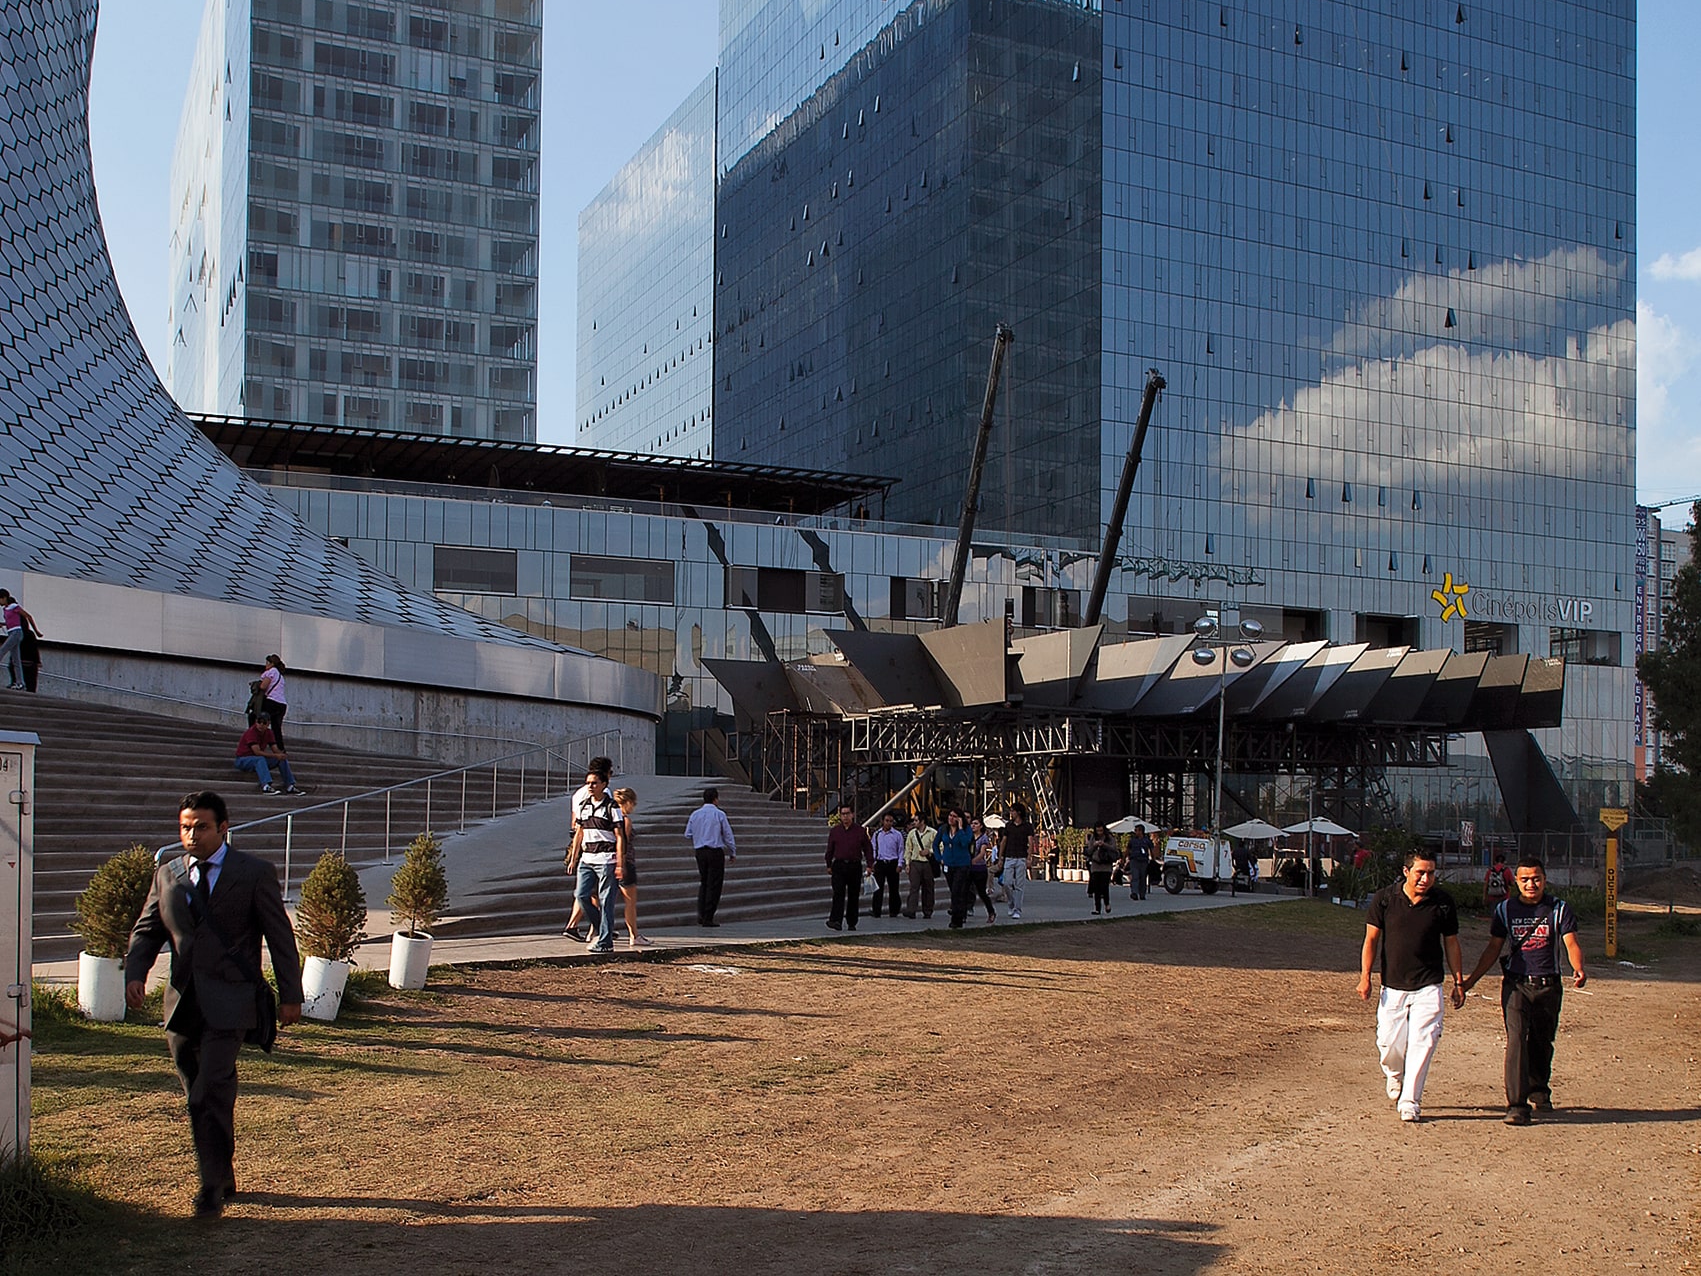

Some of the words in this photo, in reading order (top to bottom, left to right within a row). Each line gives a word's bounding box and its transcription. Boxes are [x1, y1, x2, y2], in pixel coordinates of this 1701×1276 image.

[1635, 586, 1643, 652] ENTREGA
[1178, 840, 1207, 851] carso
[1223, 850, 1229, 859] 7
[1607, 912, 1615, 945] PEMEX
